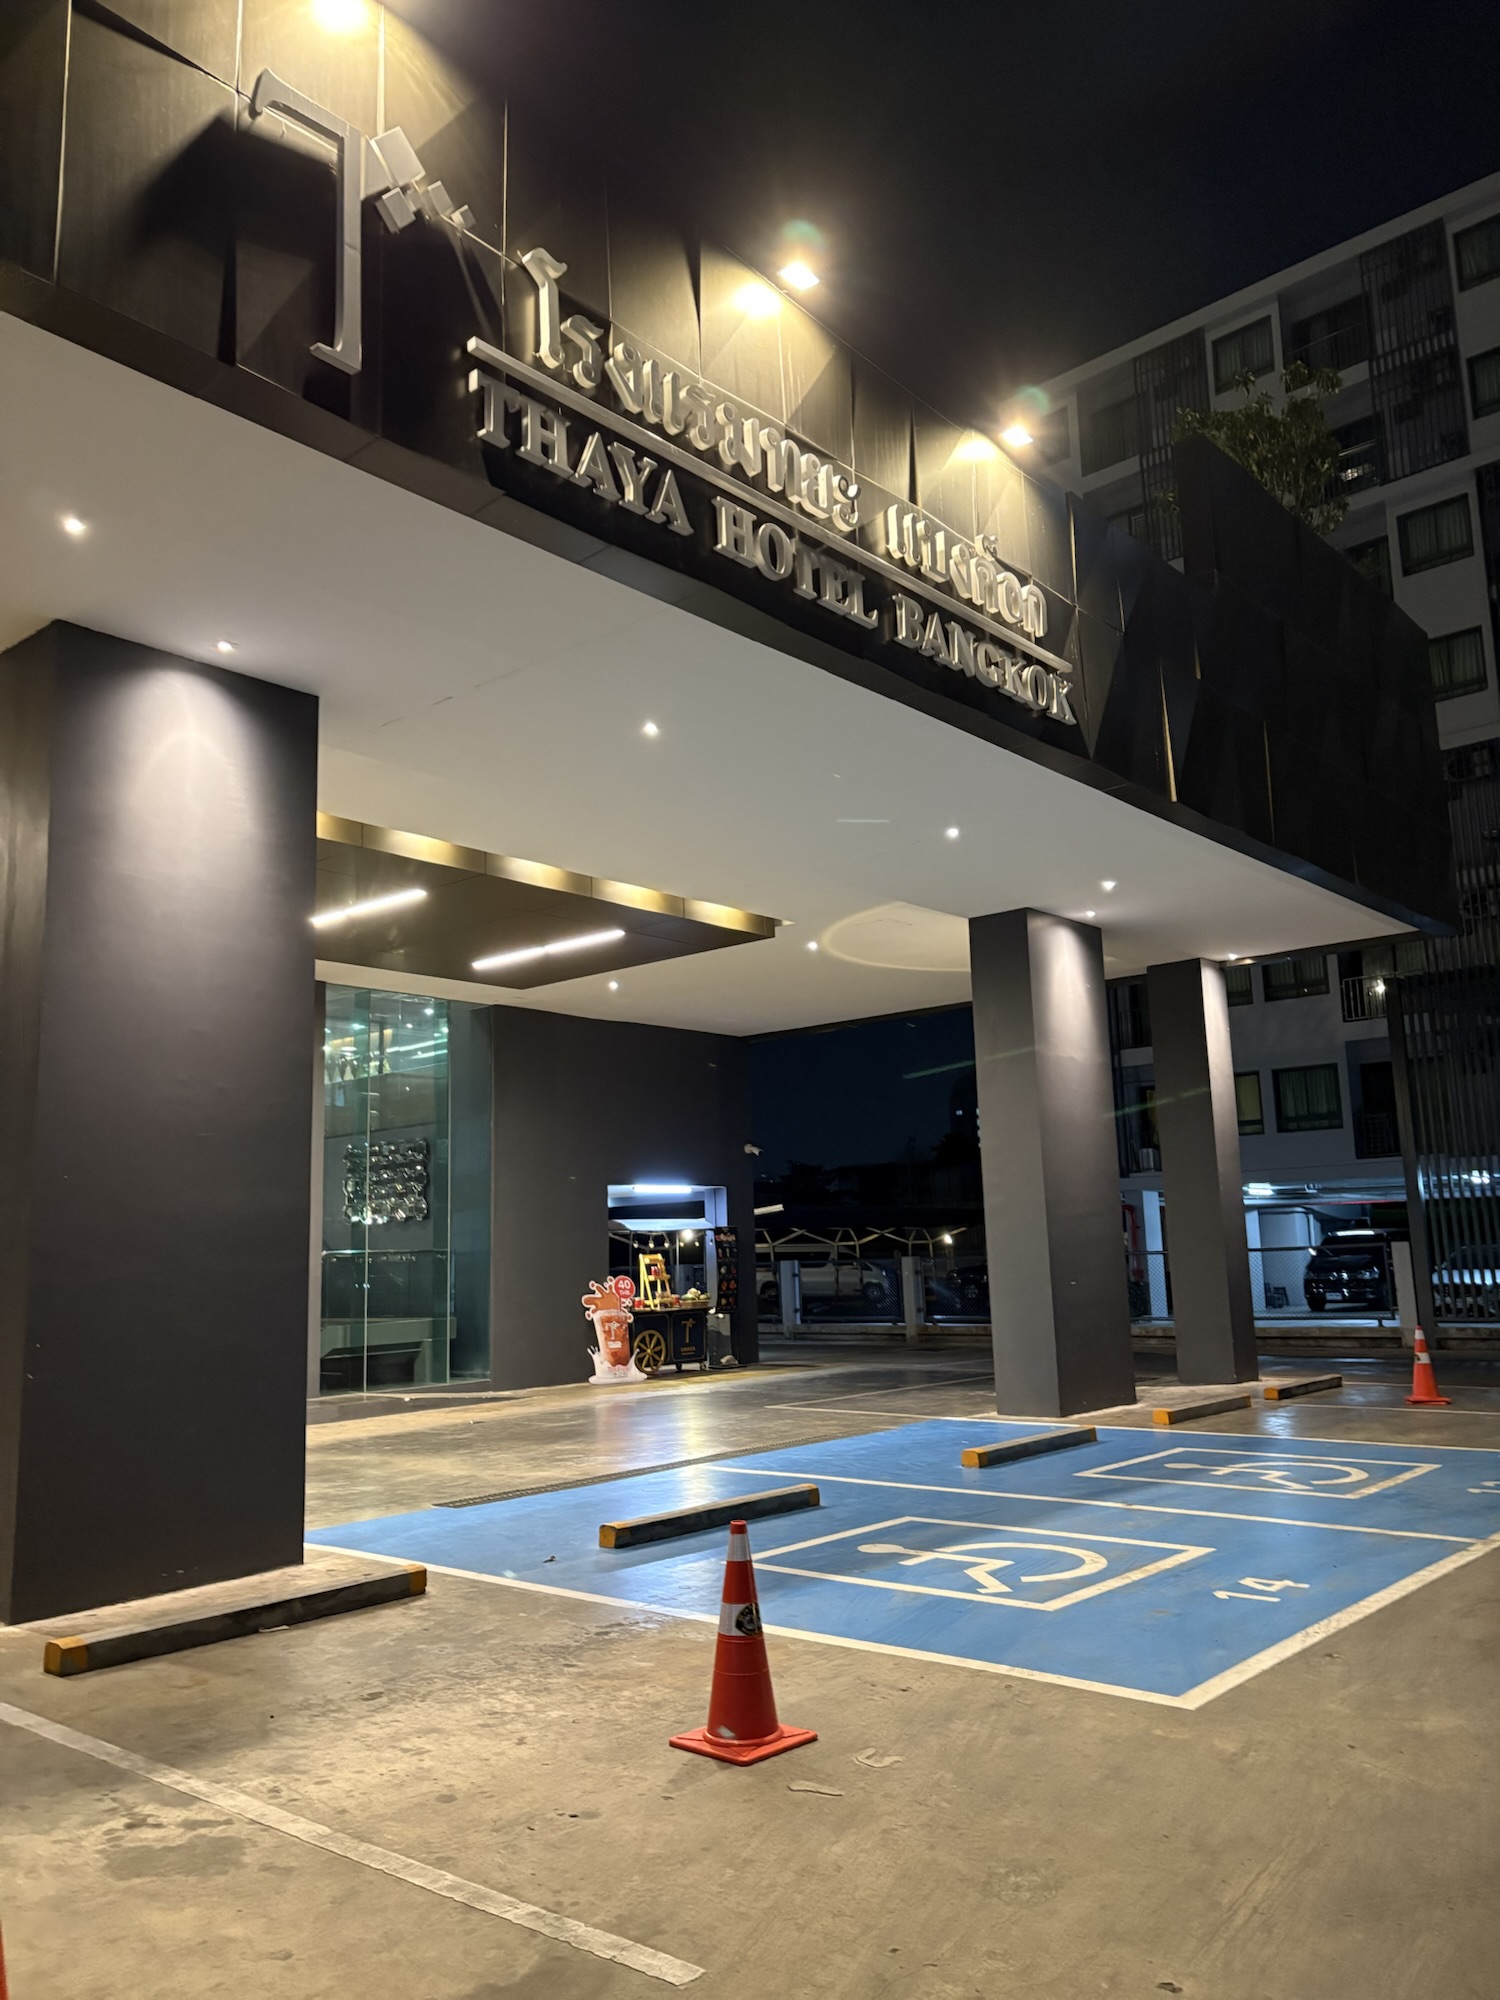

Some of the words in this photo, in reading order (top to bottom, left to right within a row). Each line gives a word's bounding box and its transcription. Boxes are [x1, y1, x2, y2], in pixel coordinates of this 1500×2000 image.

[468, 368, 694, 536] THAYA
[711, 495, 879, 629] HOTEL
[892, 593, 1077, 725] BANGKOK
[617, 1279, 631, 1290] 40
[1212, 1576, 1310, 1602] 14
